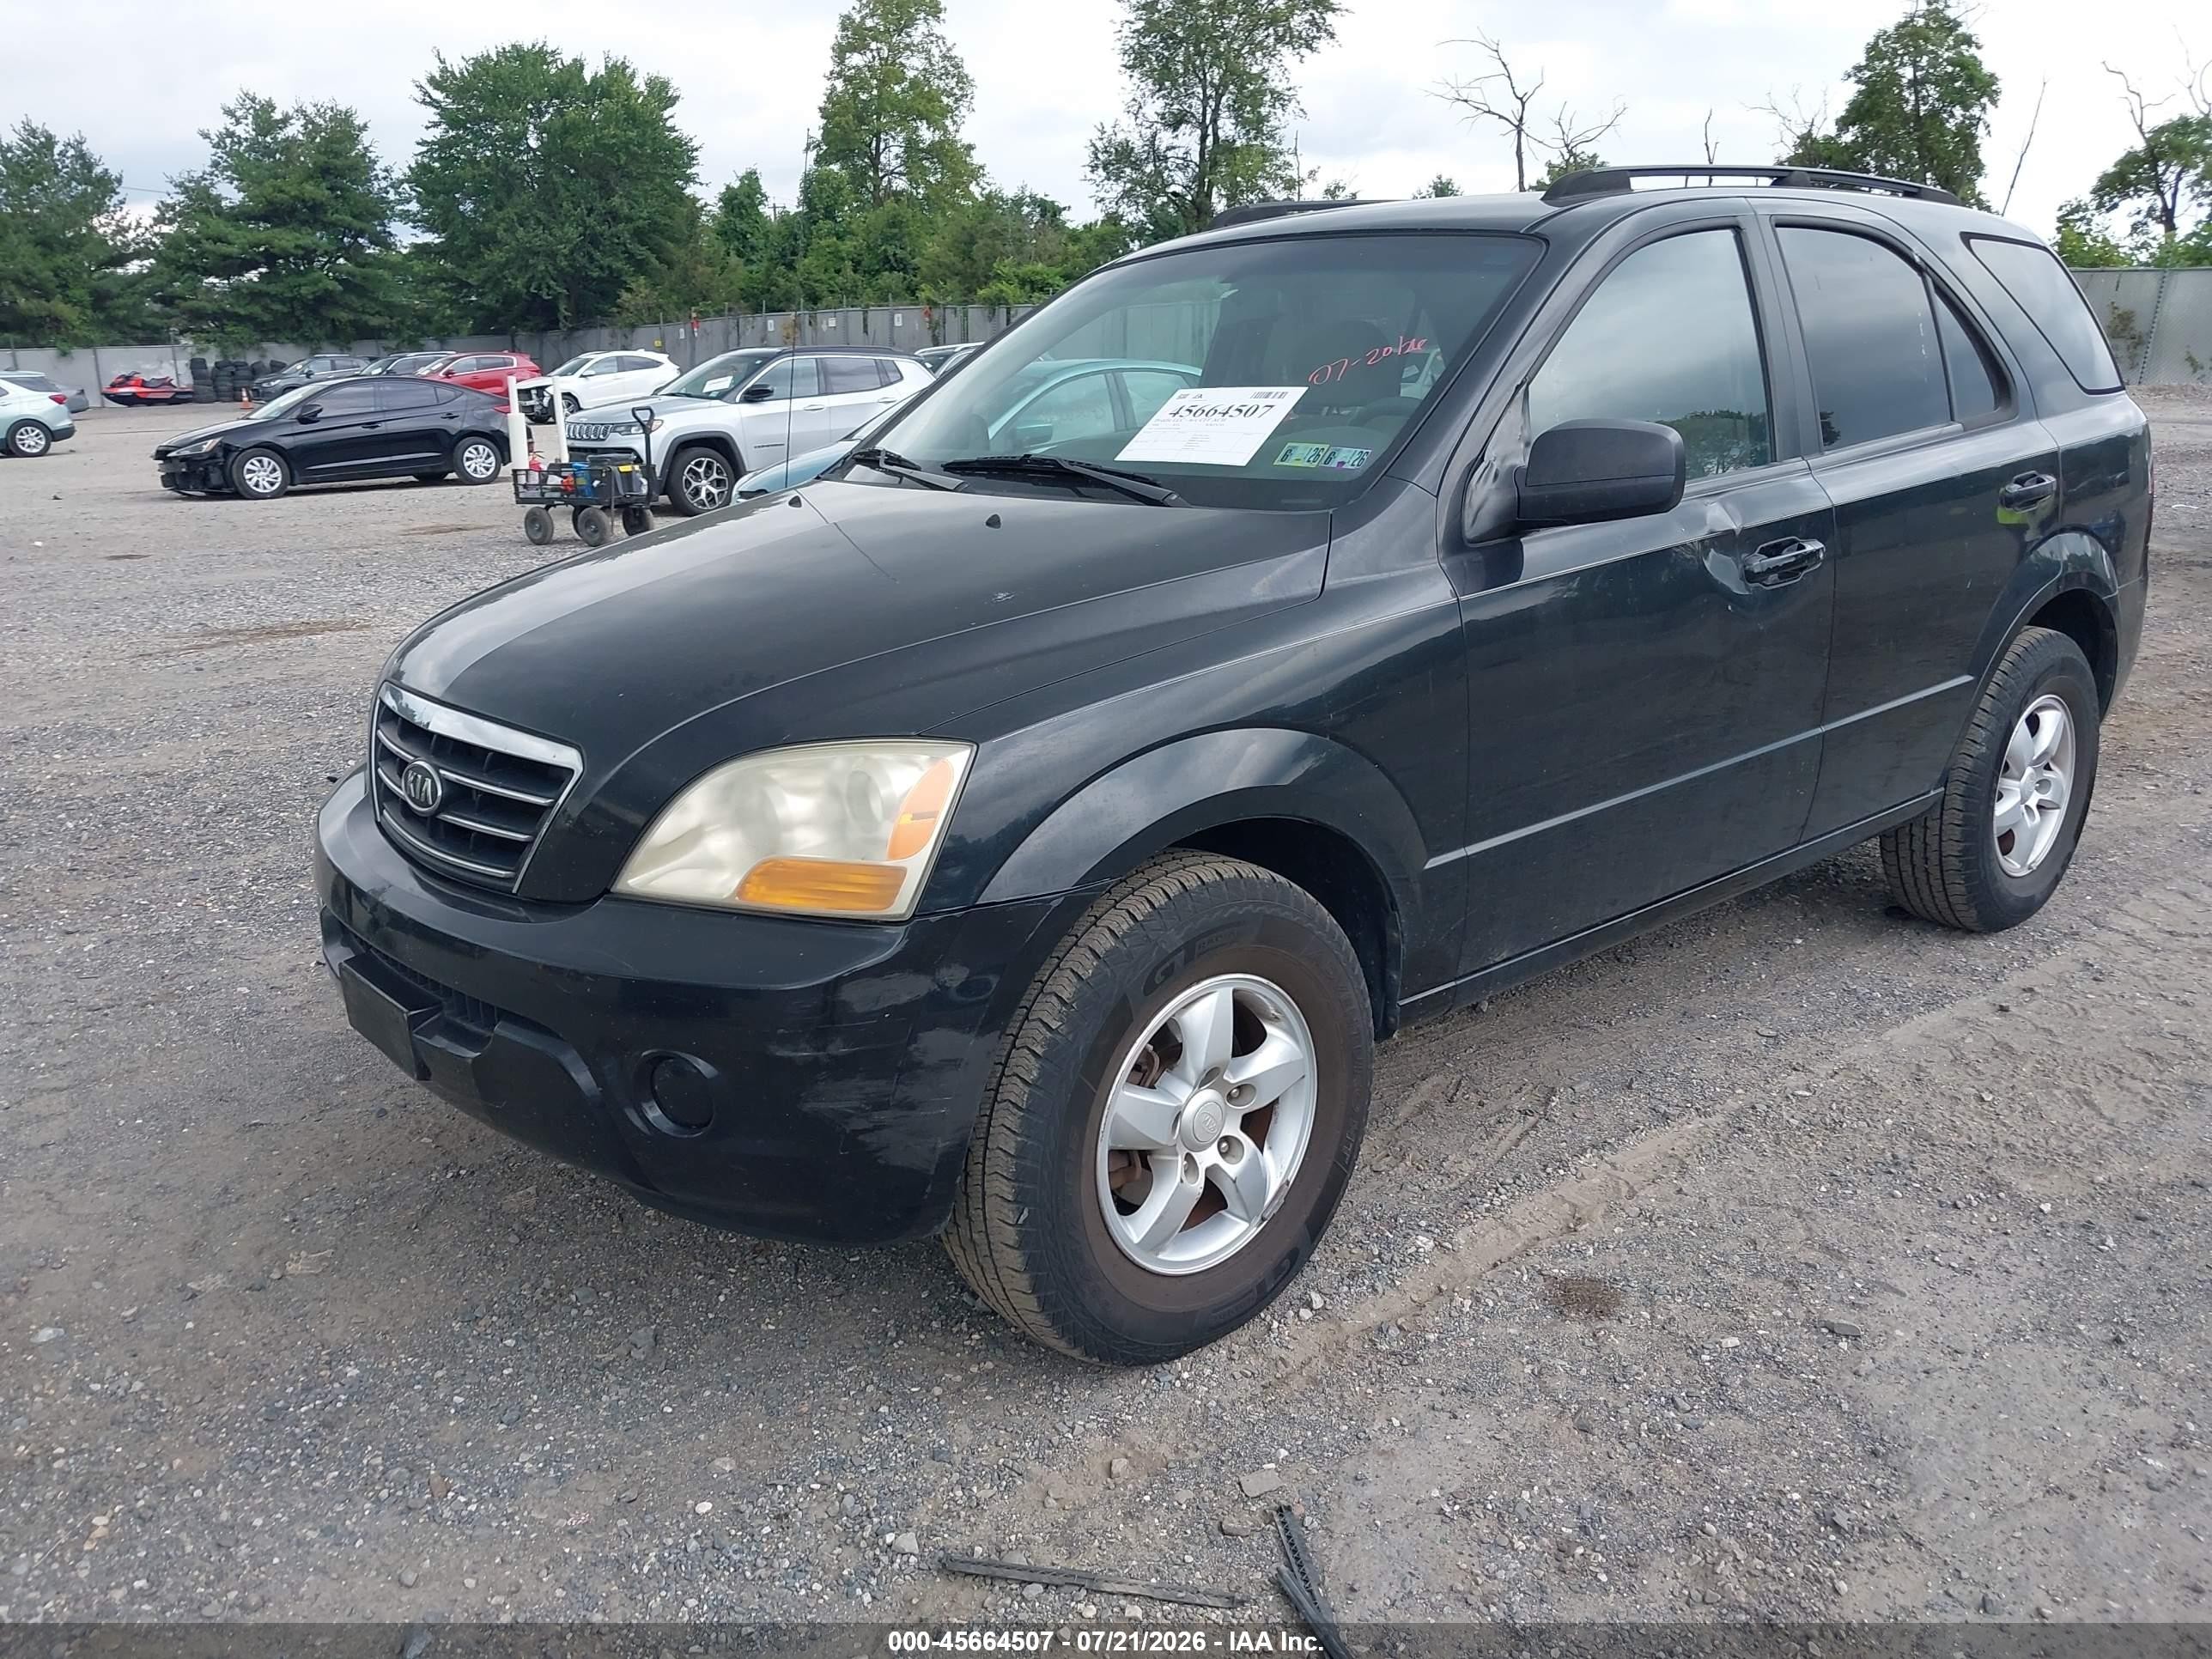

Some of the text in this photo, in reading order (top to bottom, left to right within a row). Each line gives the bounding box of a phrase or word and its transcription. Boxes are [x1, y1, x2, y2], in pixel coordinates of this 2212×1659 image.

[1169, 404, 1275, 419] 45664507
[1306, 447, 1325, 463] 26
[1351, 451, 1370, 467] 26
[407, 770, 433, 805] KIA
